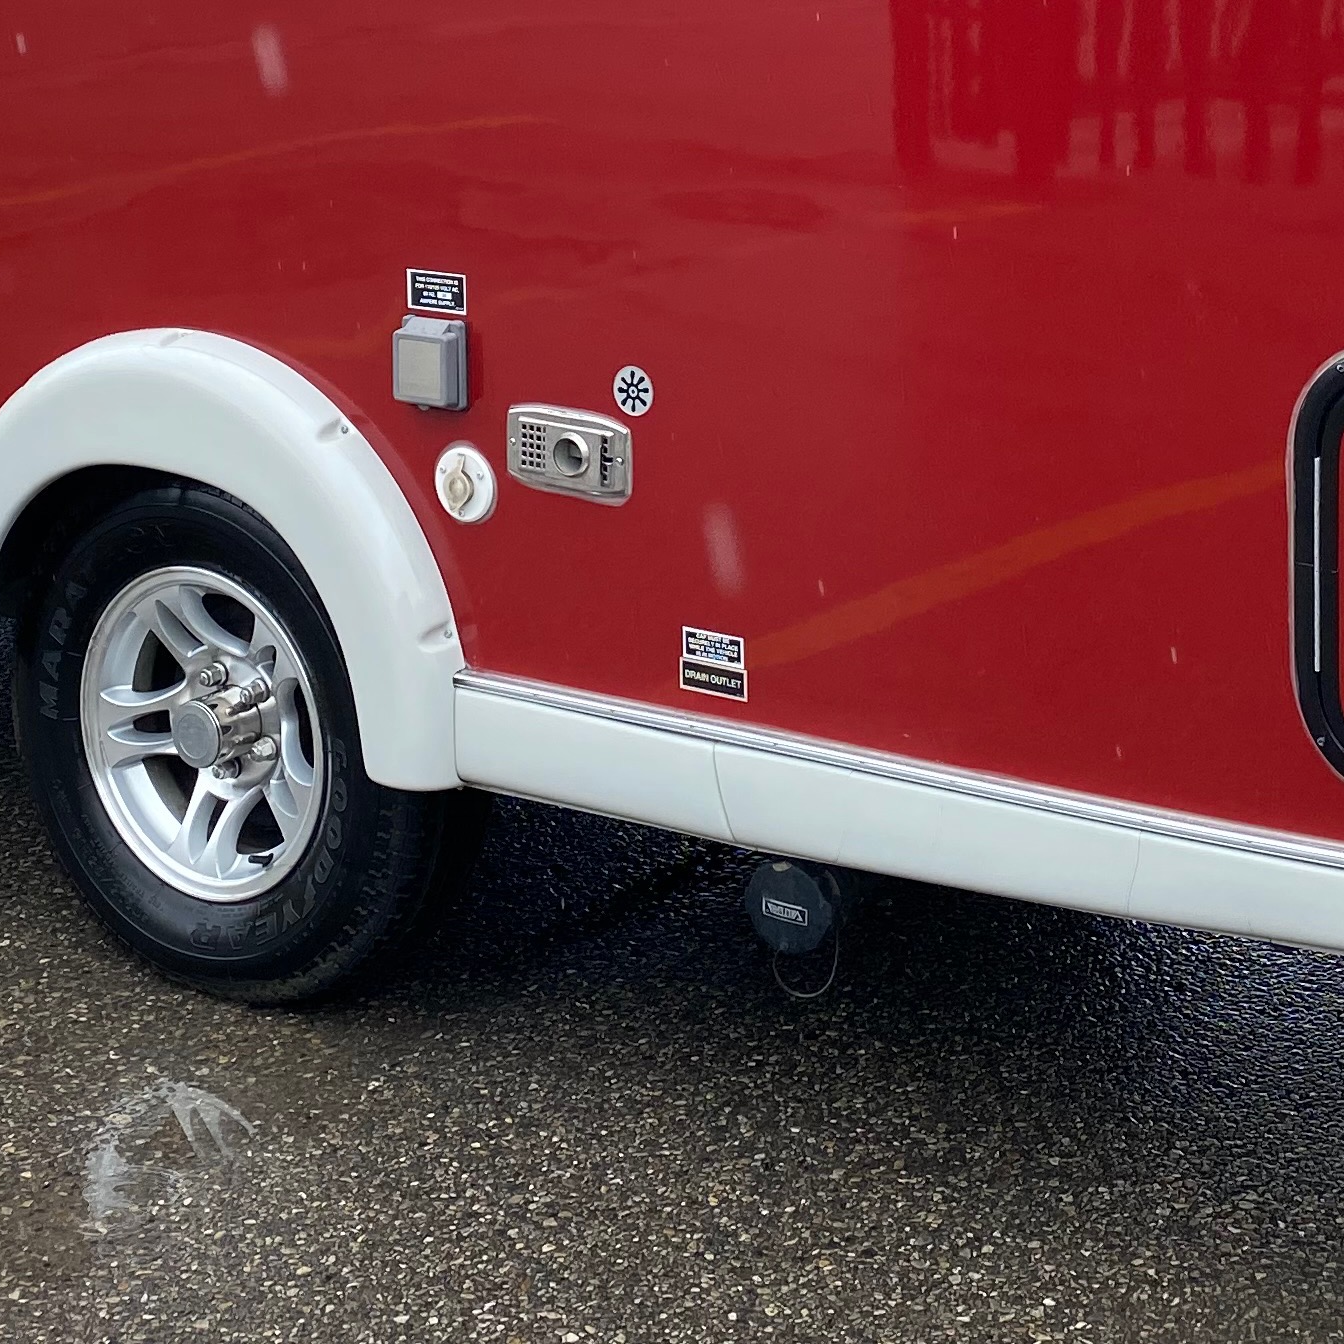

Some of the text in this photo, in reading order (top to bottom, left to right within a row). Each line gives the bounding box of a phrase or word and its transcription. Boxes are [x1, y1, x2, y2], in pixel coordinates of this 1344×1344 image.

[684, 669, 742, 689] DRAIN OUTLET
[191, 738, 347, 949] GOODYEAR
